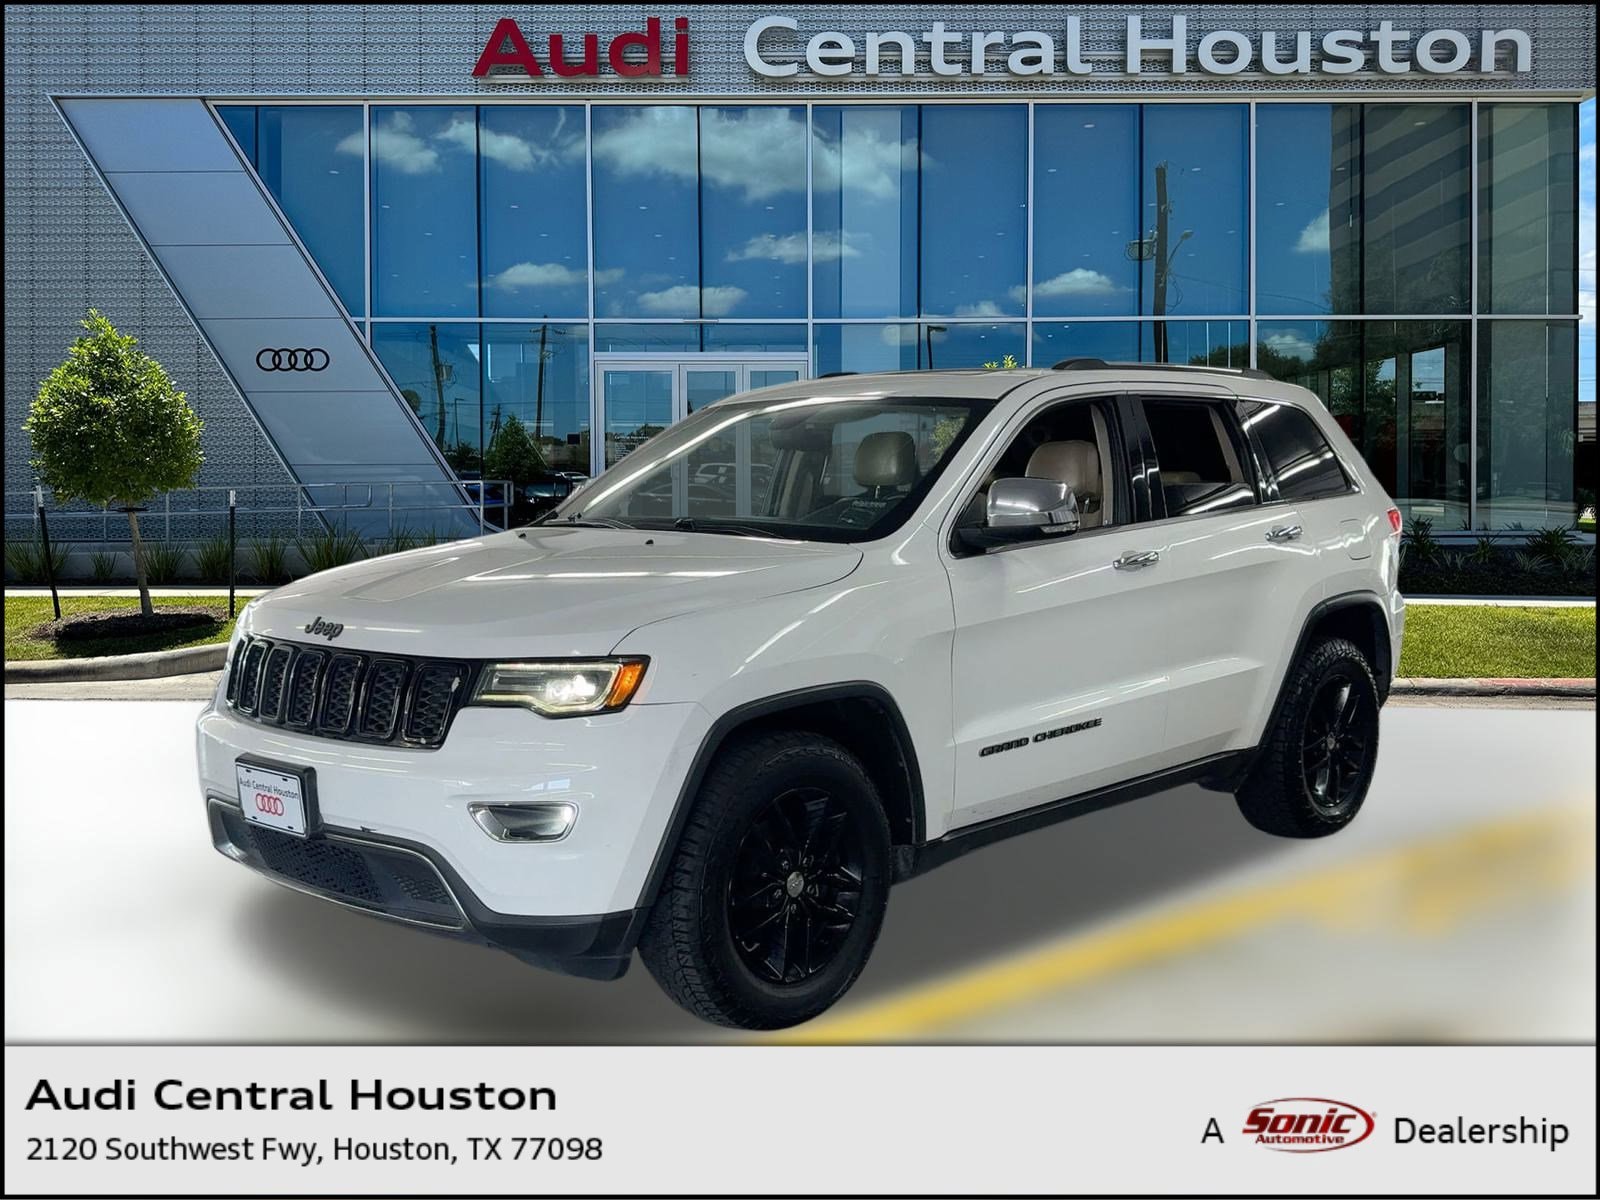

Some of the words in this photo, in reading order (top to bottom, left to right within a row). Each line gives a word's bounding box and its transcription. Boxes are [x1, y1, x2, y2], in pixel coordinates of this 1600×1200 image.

[471, 17, 689, 78] Audi
[743, 15, 1093, 78] Central
[1126, 15, 1533, 76] Houston
[304, 616, 344, 641] Jeep
[979, 737, 1030, 757] GRAND
[1032, 718, 1102, 742] CHEROKEE
[253, 780, 273, 793] Central
[274, 785, 299, 798] Houston
